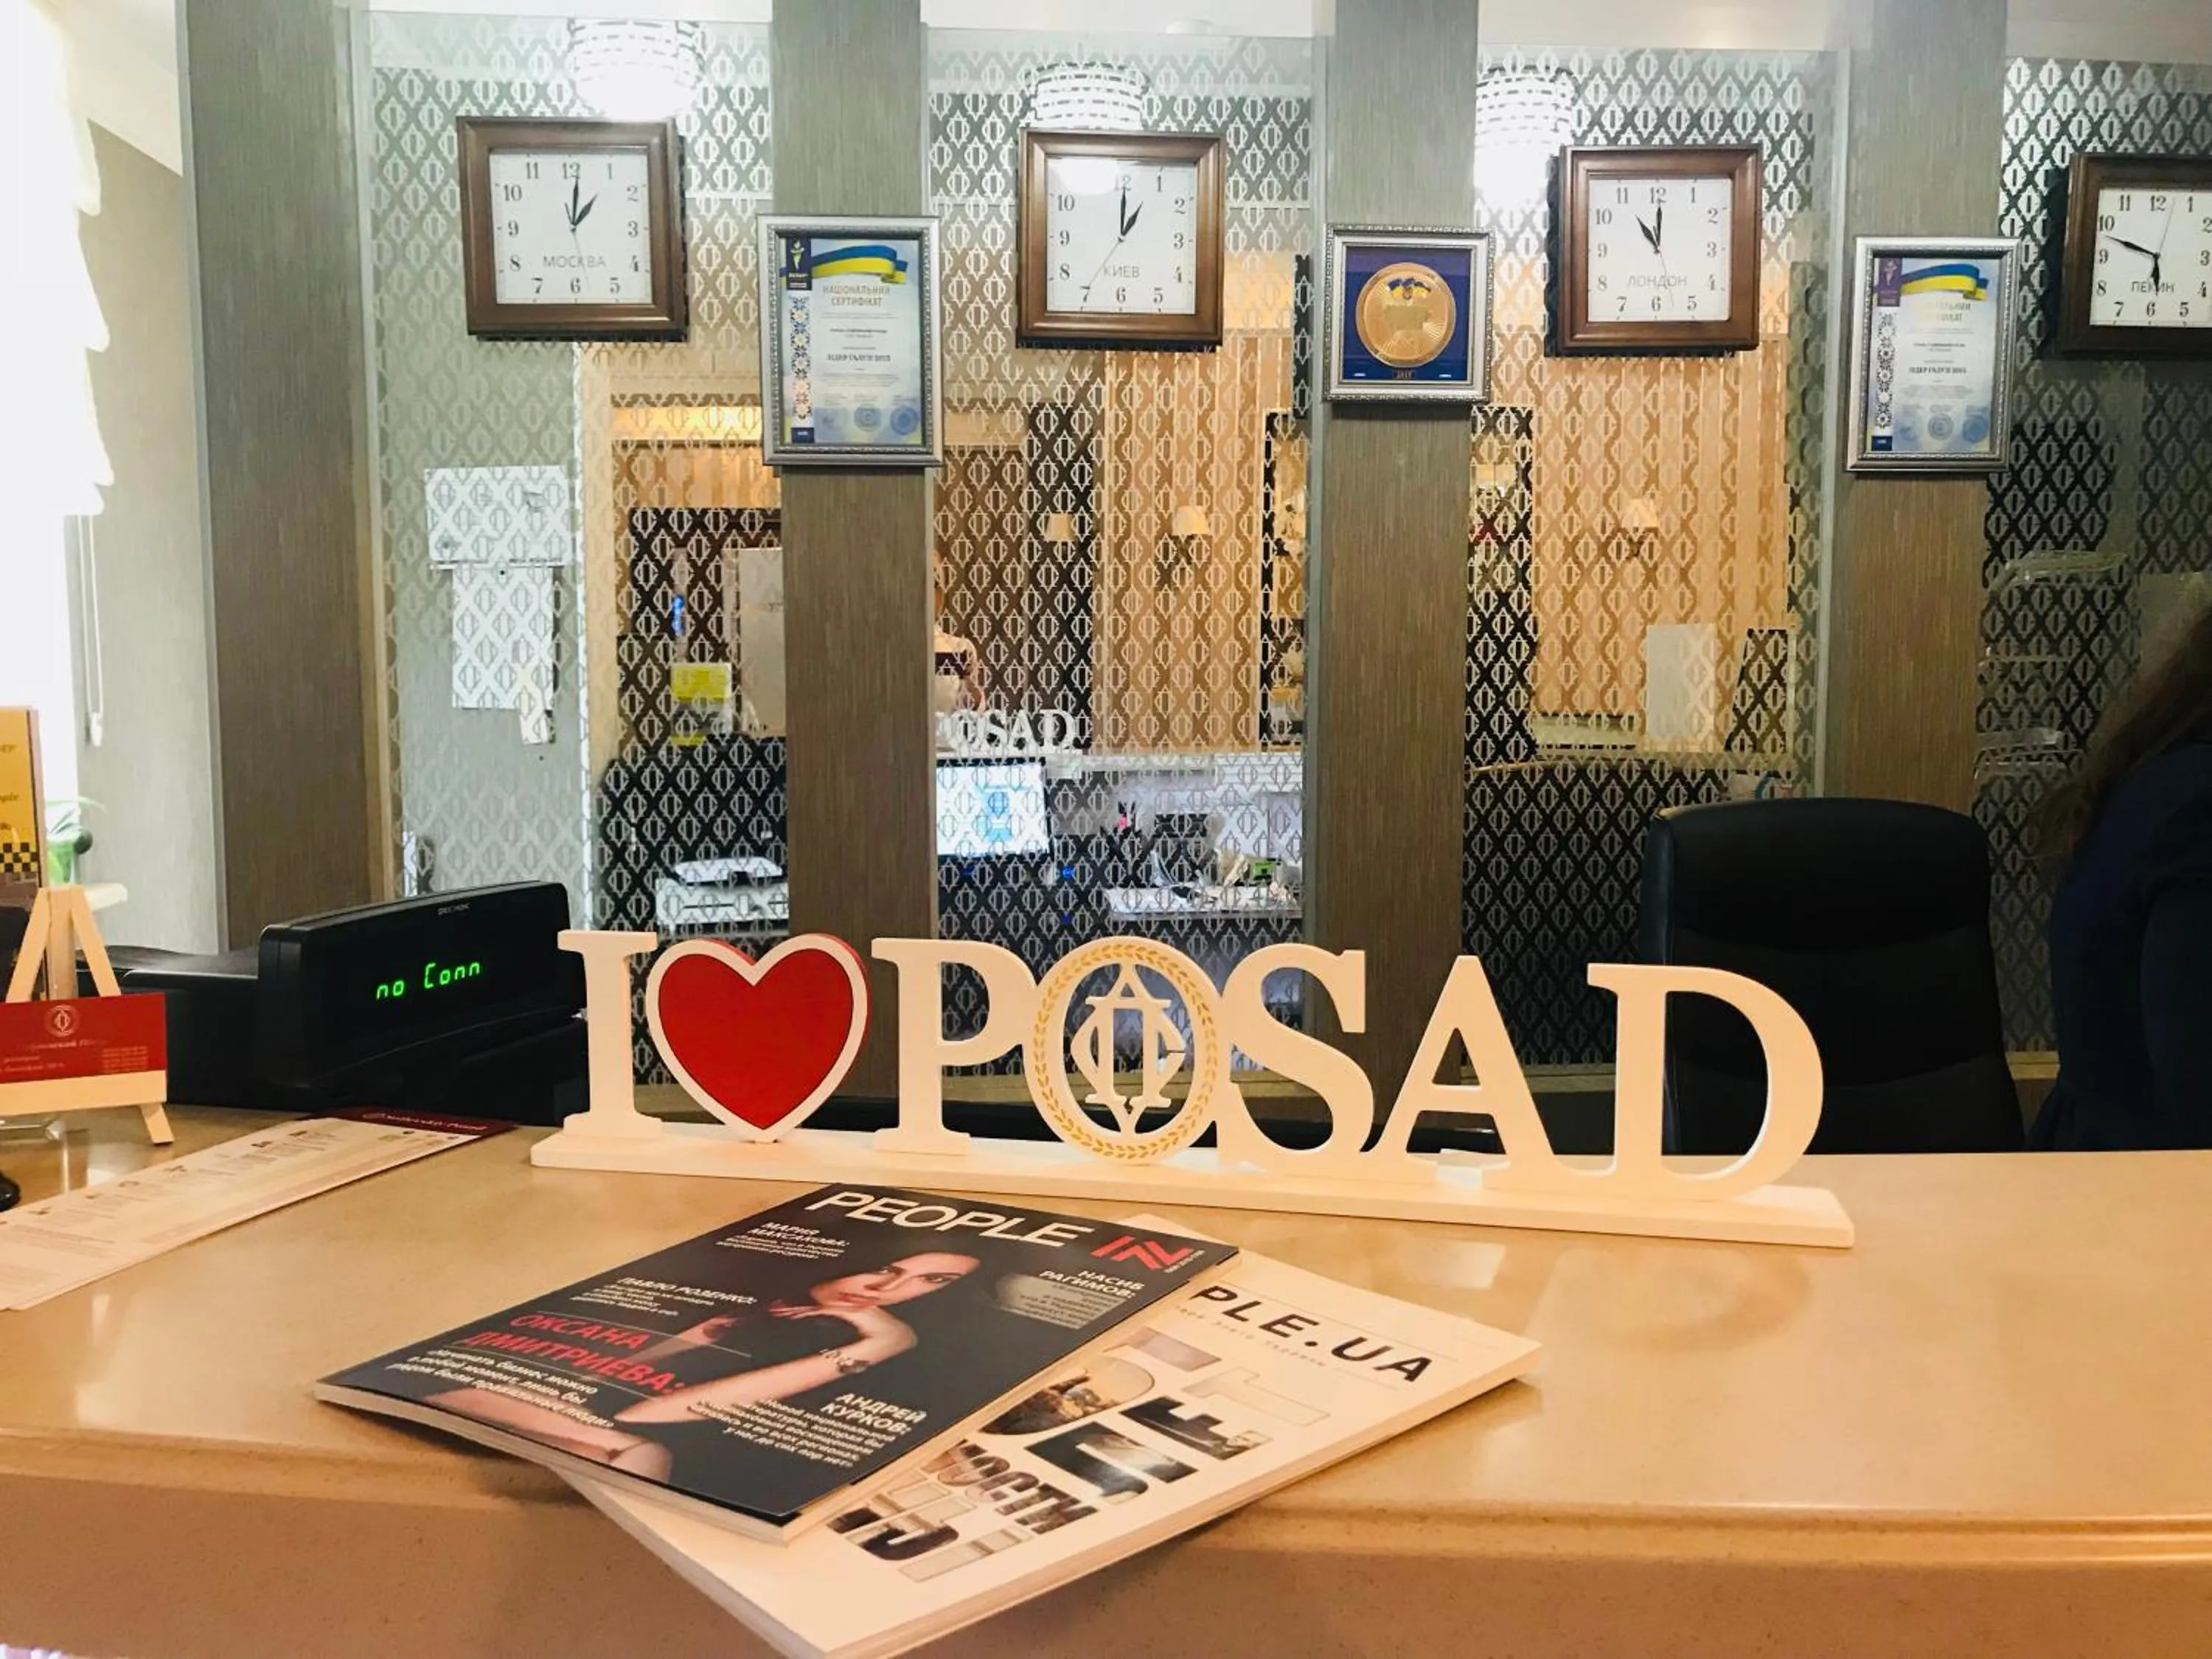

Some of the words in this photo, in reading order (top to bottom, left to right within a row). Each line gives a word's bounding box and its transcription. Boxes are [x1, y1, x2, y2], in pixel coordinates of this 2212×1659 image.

[525, 162, 540, 179] 11
[607, 163, 613, 179] 1
[1156, 174, 1162, 192] 1
[503, 184, 522, 201] 10
[626, 186, 639, 201] 2
[1616, 187, 1629, 204] 11
[1649, 187, 1666, 204] 12
[1690, 187, 1696, 204] 1
[1057, 195, 1074, 211] 10
[1174, 198, 1186, 215] 2
[2119, 195, 2131, 212] 11
[2150, 195, 2167, 212] 12
[2187, 196, 2194, 212] 1
[1596, 209, 1613, 225] 10
[1707, 208, 1719, 224] 2
[2098, 215, 2115, 232] 10
[507, 220, 519, 237] 9
[627, 220, 639, 237] 3
[1060, 230, 1070, 246] 9
[1173, 232, 1183, 249] 3
[1597, 243, 1607, 258] 9
[1706, 242, 1717, 258] 3
[2098, 248, 2109, 264] 9
[2200, 251, 2211, 266] 3
[509, 255, 521, 271] 8
[543, 255, 607, 268] МОСКВА
[629, 255, 639, 272] 4
[1060, 265, 1070, 280] 8
[1104, 265, 1141, 278] КИЕВ
[1174, 265, 1183, 283] 4
[531, 277, 543, 293] 7
[570, 277, 581, 293] 6
[609, 277, 621, 293] 5
[1597, 275, 1607, 291] 8
[1627, 275, 1688, 288] ЛОНДОН
[1707, 274, 1716, 291] 4
[2097, 281, 2107, 296] 8
[2198, 281, 2207, 298] 4
[1080, 285, 1091, 302] 7
[1116, 287, 1126, 303] 6
[1153, 287, 1163, 304] 5
[1616, 296, 1627, 313] 7
[1652, 296, 1661, 312] 6
[1687, 296, 1697, 312] 5
[2114, 302, 2124, 317] 7
[2146, 302, 2156, 317] 6
[2180, 302, 2189, 317] 5
[936, 709, 1076, 751] OSAD
[376, 978, 406, 1000] no
[423, 961, 481, 990] Conn
[871, 935, 1824, 1202] POSAD
[804, 1190, 1096, 1248] PEOPLE
[509, 1313, 652, 1351] ОКСАНА
[1189, 1285, 1433, 1382] PLE.UA
[464, 1330, 685, 1394] ДМИТРИЕВА:
[561, 1391, 588, 1405] бы
[834, 1391, 927, 1424] АНДРЕЙ
[820, 1402, 913, 1436] КУРКОВ:
